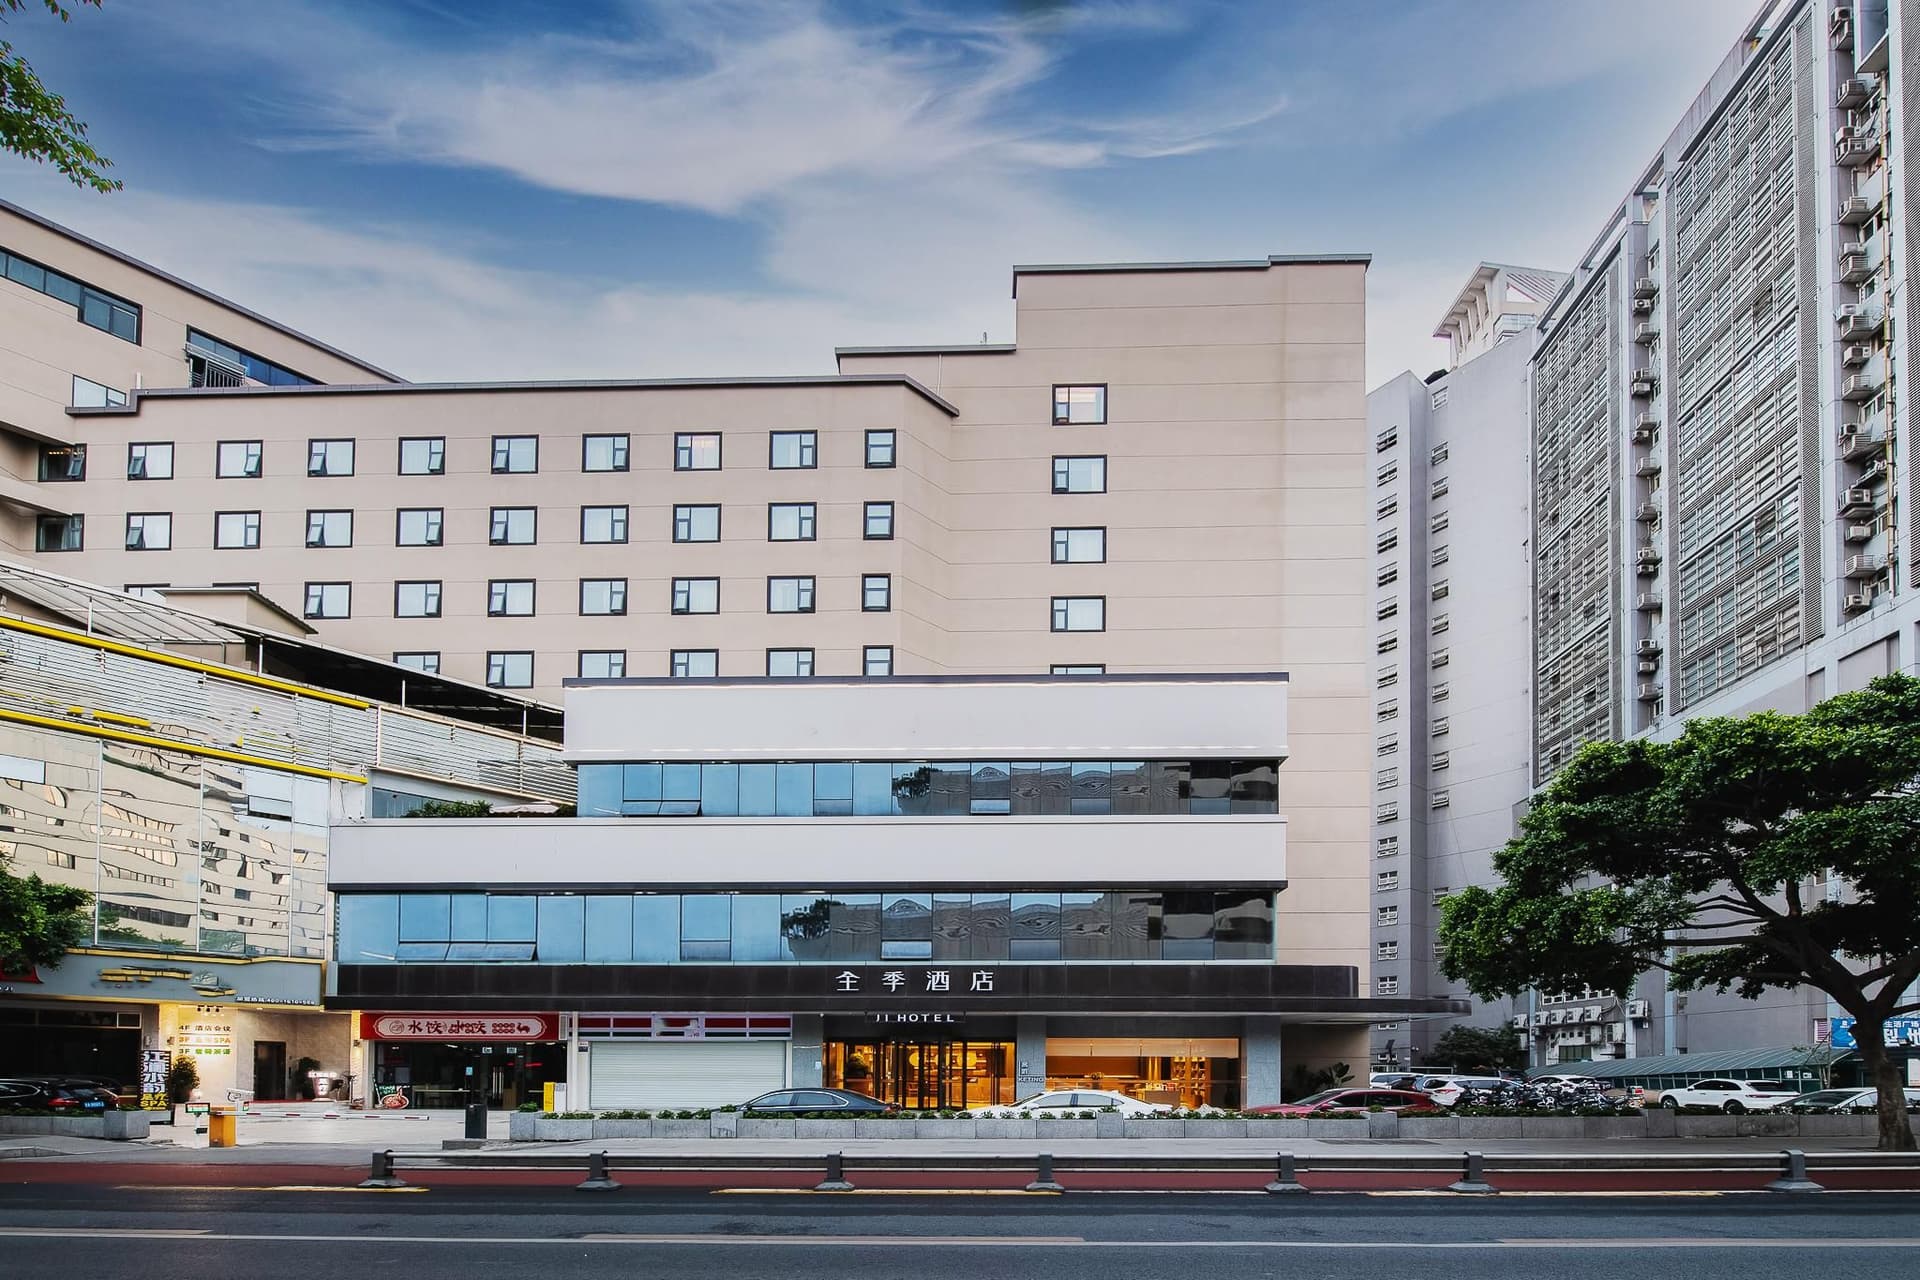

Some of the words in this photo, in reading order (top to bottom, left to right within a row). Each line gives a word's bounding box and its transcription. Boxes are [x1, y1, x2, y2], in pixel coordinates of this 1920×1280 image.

[835, 970, 994, 993] 全季酒店
[876, 1013, 889, 1023] JI
[897, 1013, 955, 1023] HOTEL
